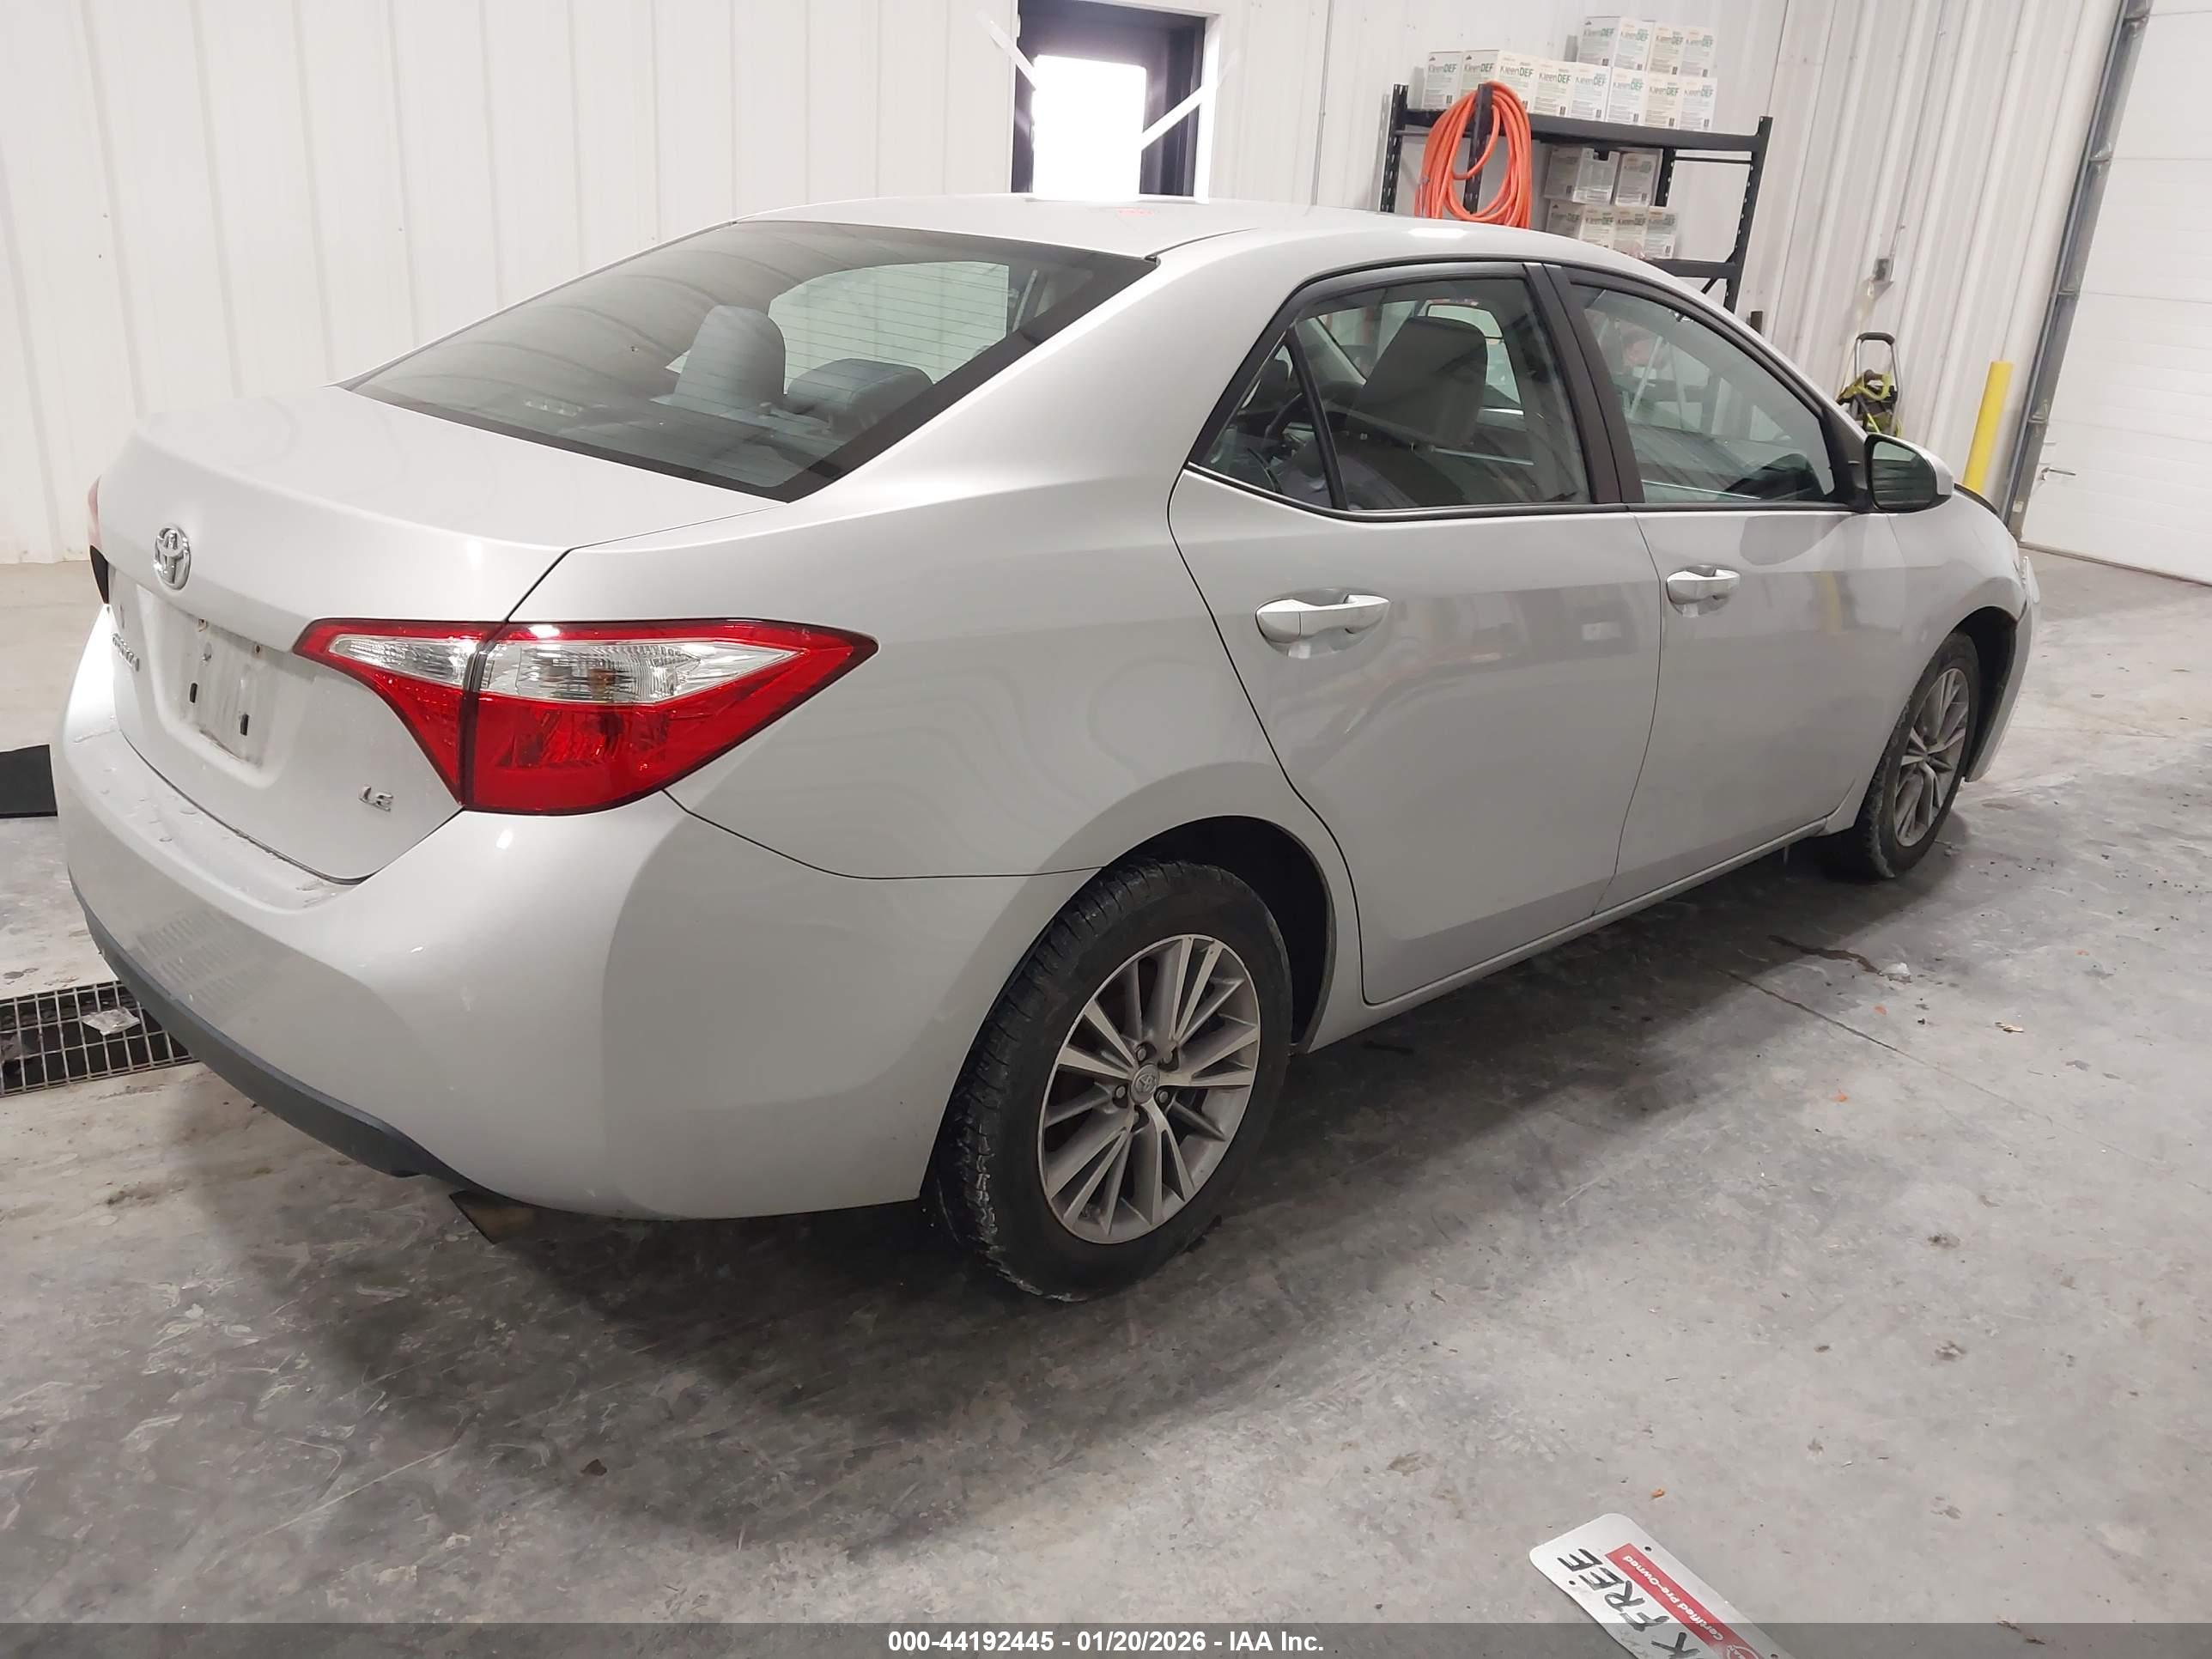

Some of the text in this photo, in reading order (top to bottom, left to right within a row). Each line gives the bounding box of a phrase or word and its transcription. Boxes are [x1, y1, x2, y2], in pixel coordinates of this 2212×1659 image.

[359, 786, 393, 812] LE
[1557, 1548, 1669, 1632] FREE
[1622, 1555, 1724, 1641] Certified Pre-Owned
